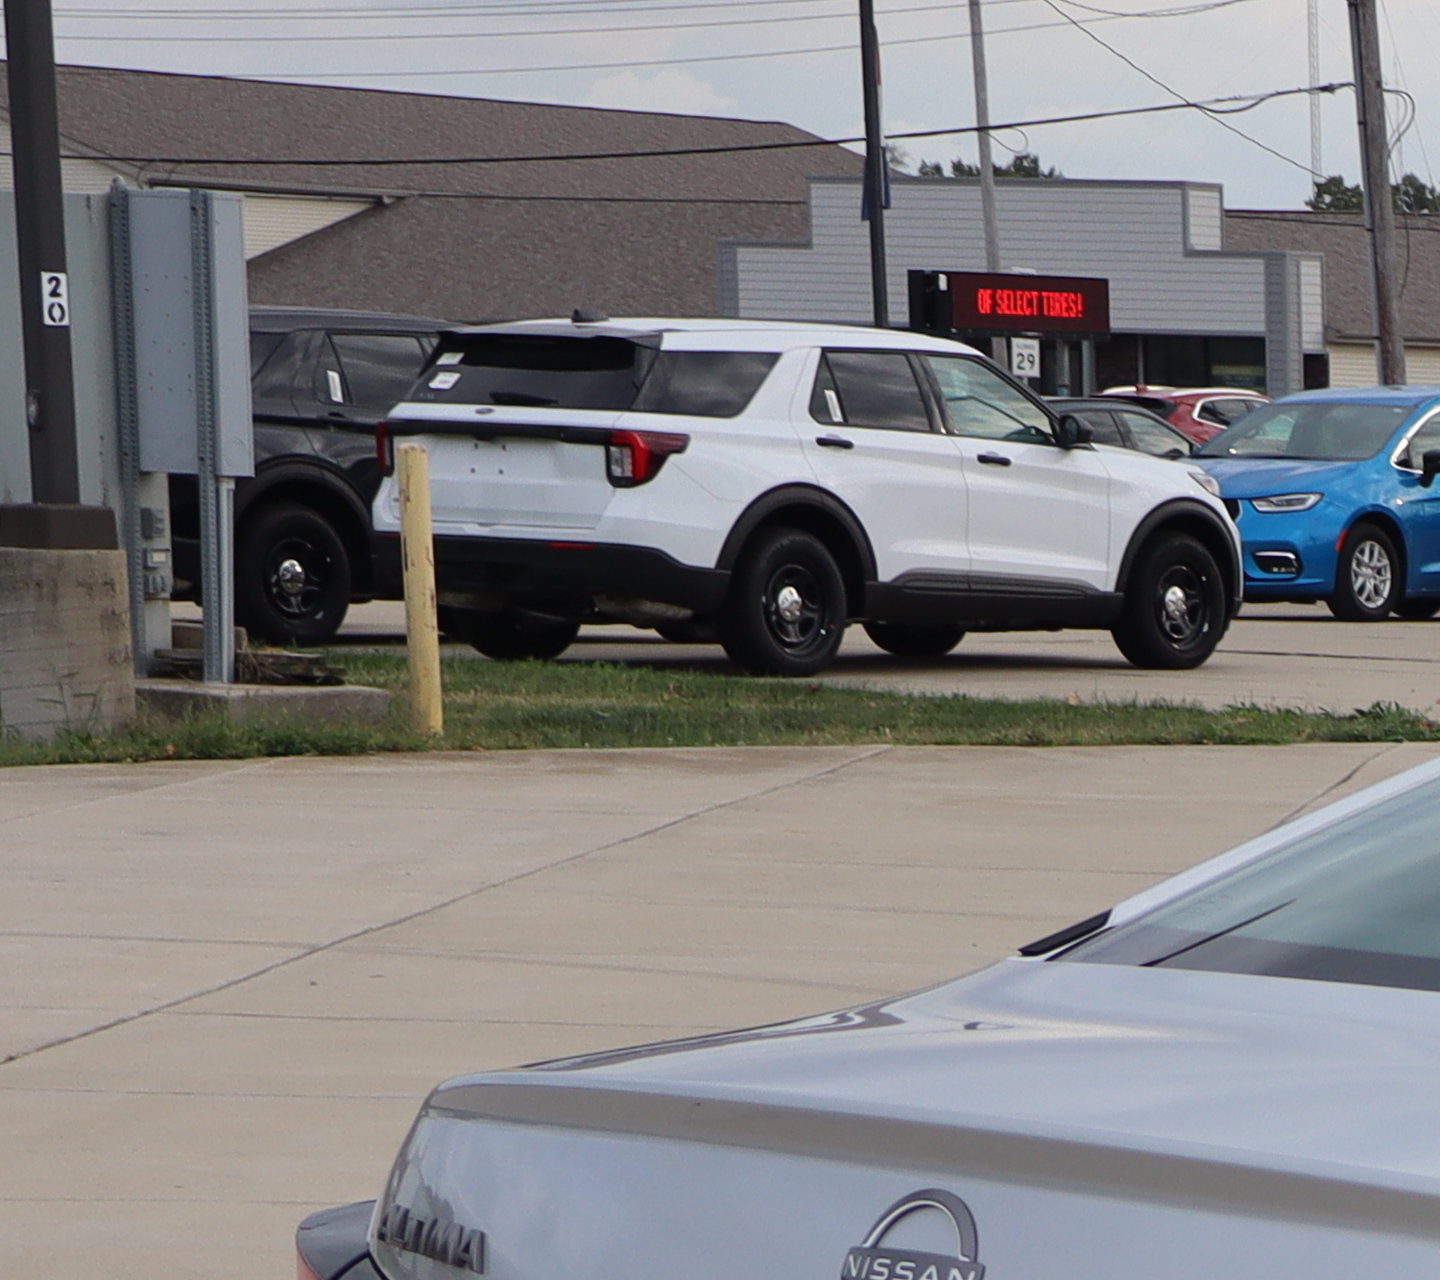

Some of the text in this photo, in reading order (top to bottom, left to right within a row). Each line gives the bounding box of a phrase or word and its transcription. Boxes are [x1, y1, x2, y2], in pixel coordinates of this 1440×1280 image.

[978, 288, 1084, 318] OF SELECT TIRES!
[1017, 353, 1036, 370] 29
